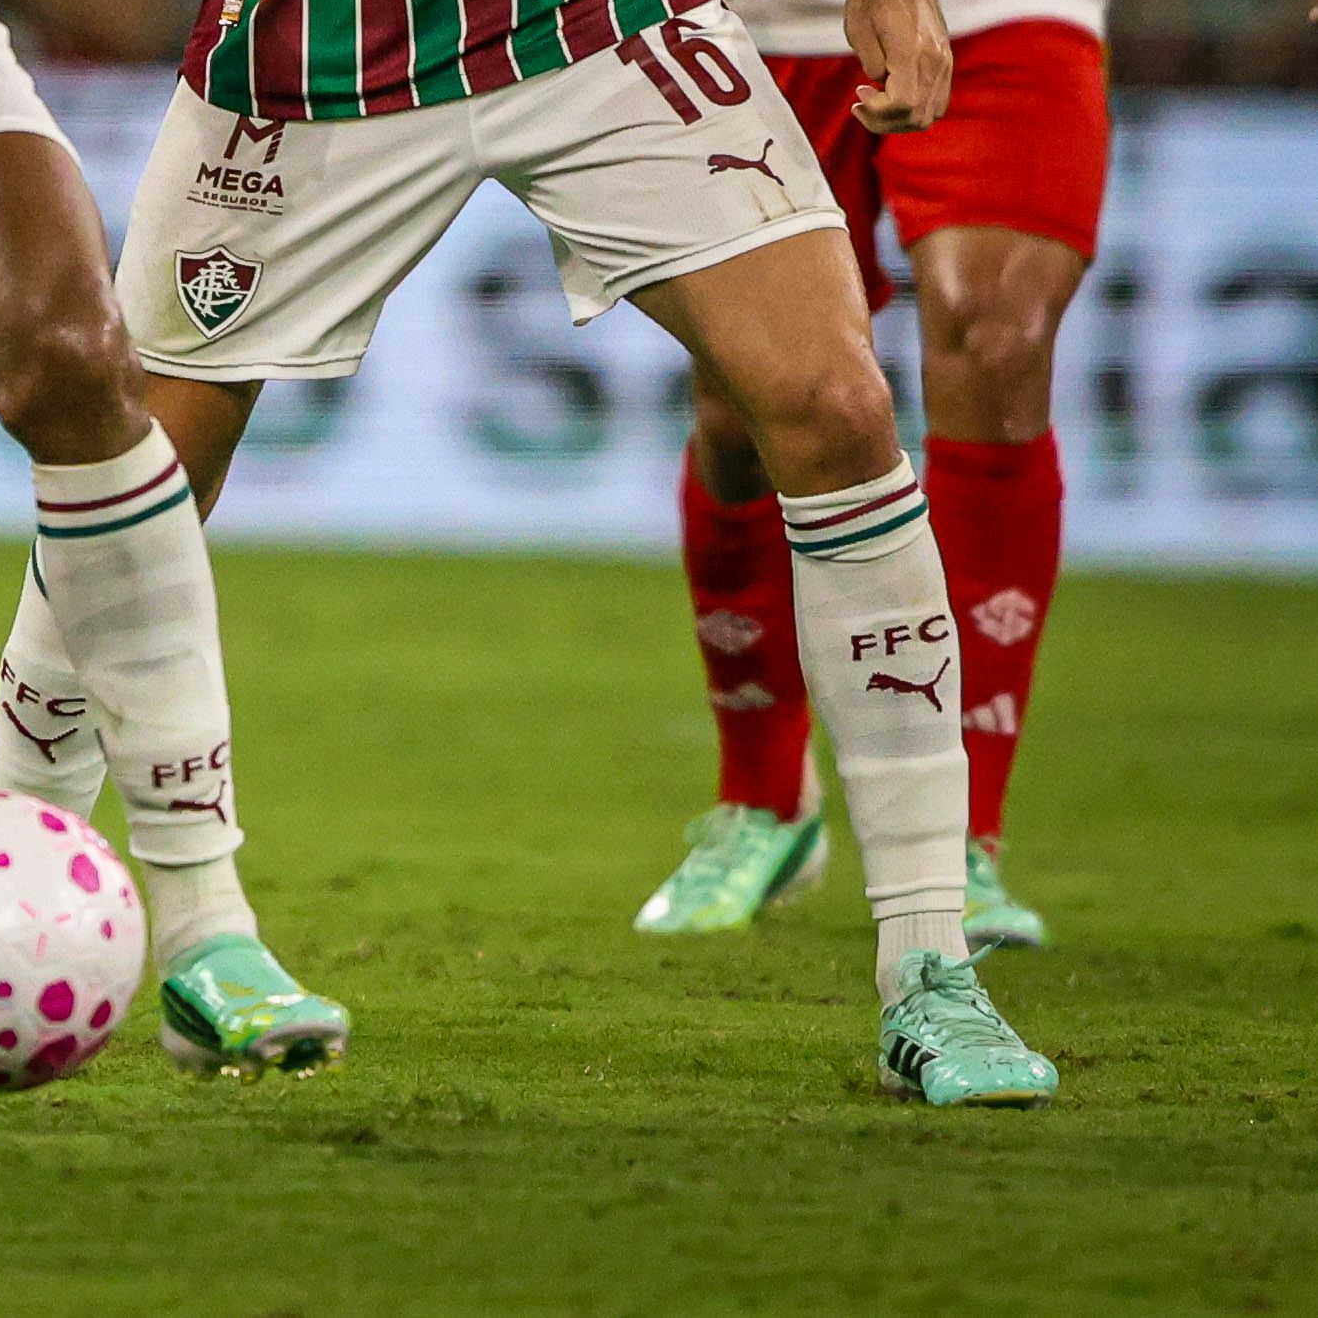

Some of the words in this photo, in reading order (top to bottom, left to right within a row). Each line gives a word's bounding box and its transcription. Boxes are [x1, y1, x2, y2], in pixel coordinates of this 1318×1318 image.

[613, 17, 751, 126] 16
[195, 162, 284, 197] MEGA
[851, 614, 950, 661] FFC
[0, 658, 86, 716] FFC
